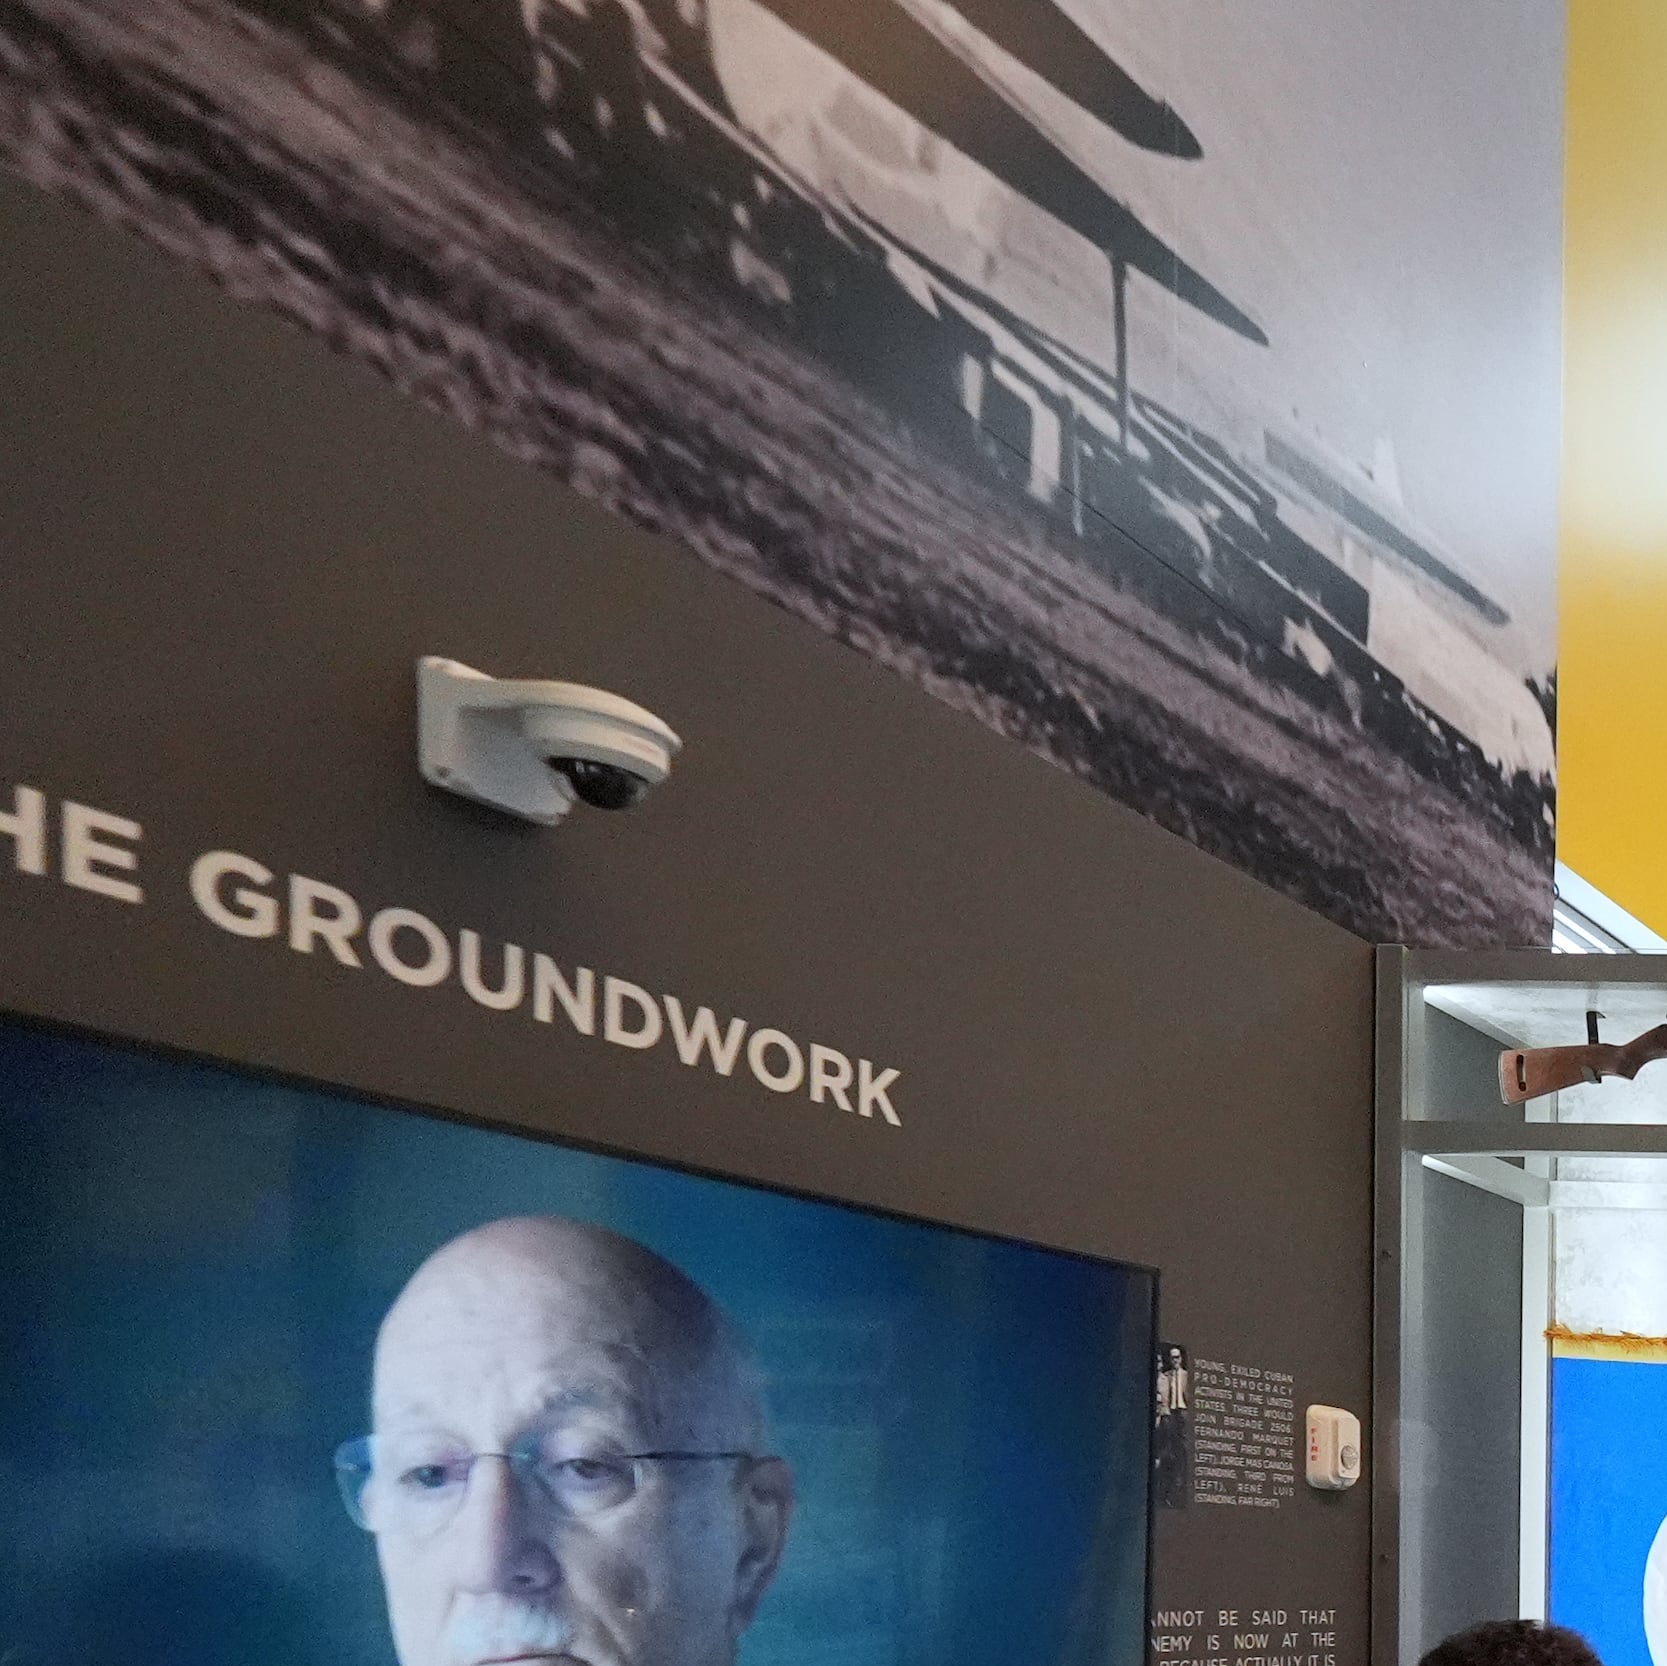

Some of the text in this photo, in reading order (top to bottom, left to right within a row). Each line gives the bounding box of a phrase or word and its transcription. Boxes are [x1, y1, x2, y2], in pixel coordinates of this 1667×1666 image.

[0, 784, 904, 1129] HE GROUNDWORK
[1194, 1372, 1292, 1395] PRO-DEMOCRACY
[1232, 1404, 1259, 1416] THREE
[1224, 1416, 1264, 1430] BRIGADE
[1194, 1425, 1244, 1440] FERNANDO
[1151, 1609, 1336, 1627] NNOT BE SAID THAT
[1151, 1632, 1336, 1653] NEMY IS NOW AT THE
